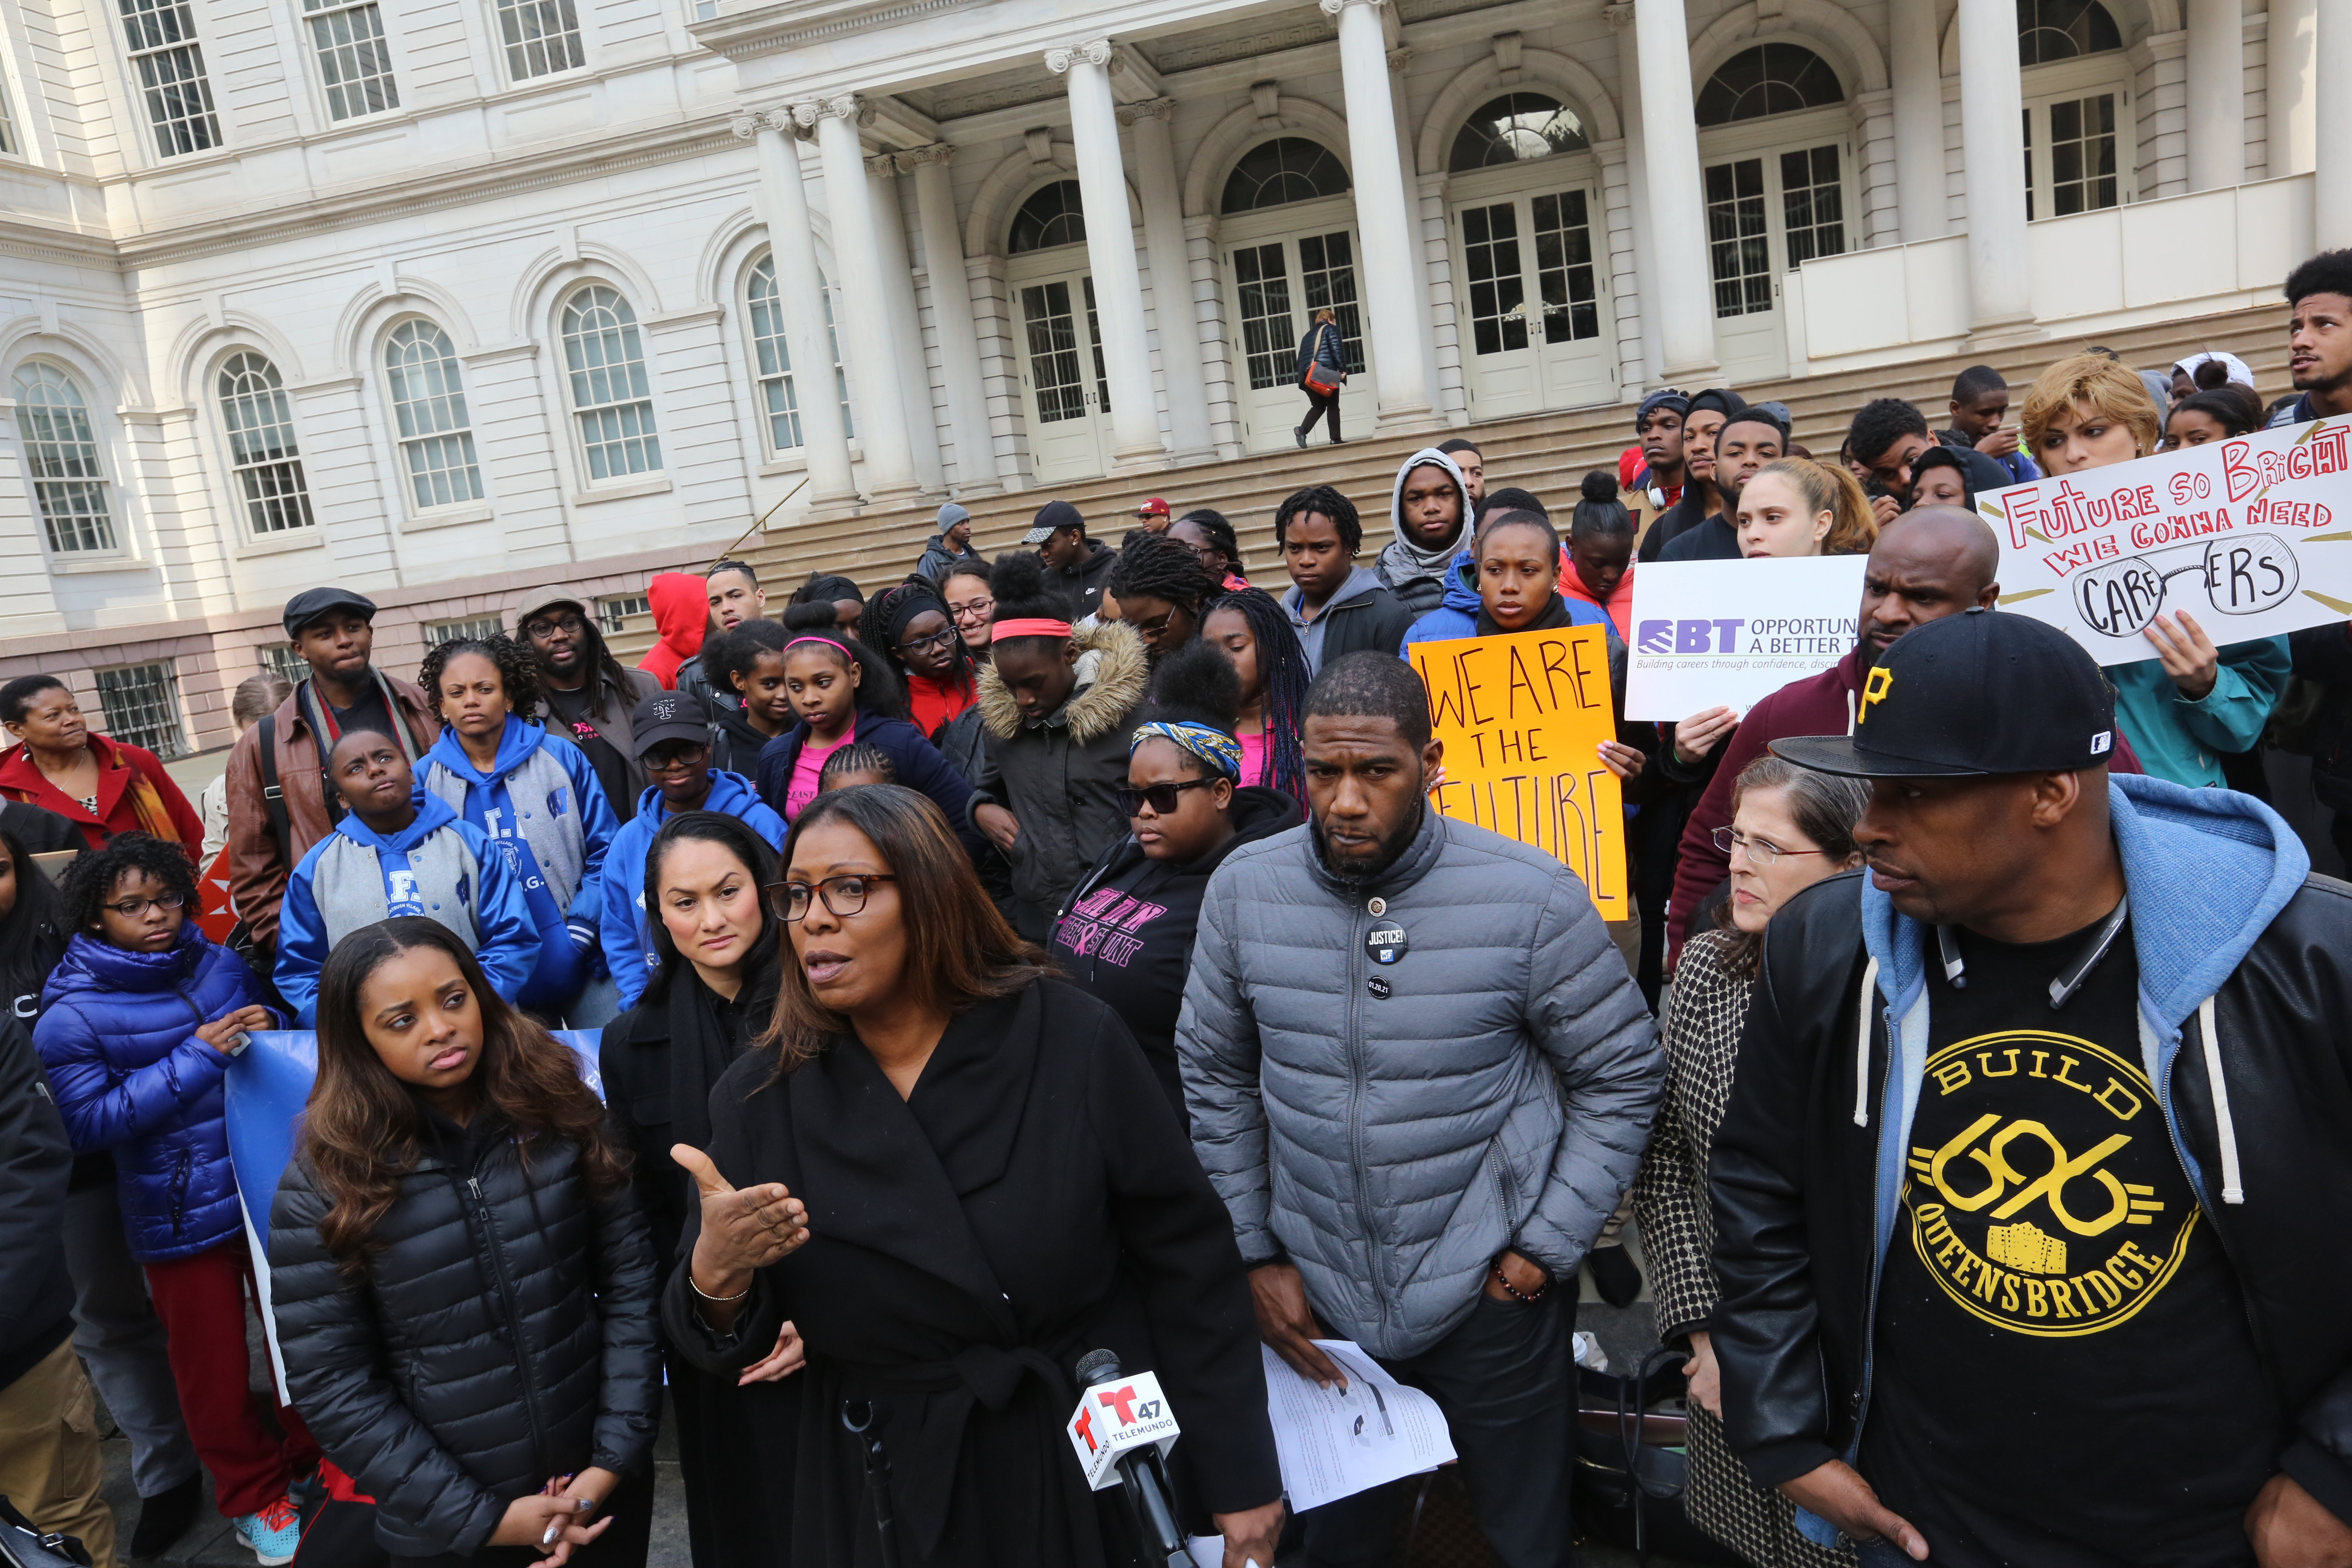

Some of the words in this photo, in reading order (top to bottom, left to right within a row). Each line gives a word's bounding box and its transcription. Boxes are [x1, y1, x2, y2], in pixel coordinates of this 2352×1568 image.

[2168, 472, 2211, 505] SO
[2043, 535, 2120, 577] WE
[2131, 508, 2233, 548] GONNA
[2247, 499, 2332, 527] NEED
[1749, 638, 1762, 653] A
[1771, 637, 1840, 653] BETTER
[1636, 659, 1673, 670] Building
[1677, 660, 1708, 669] careers
[1712, 659, 1749, 670] through
[1753, 658, 1806, 670] confidence,
[1421, 648, 1494, 728] WE
[1511, 639, 1601, 719] ARE
[1858, 666, 1893, 725] P
[1471, 728, 1548, 768] THE
[1369, 929, 1403, 945] JUSTICE!
[1368, 981, 1388, 993] 01.20.21
[1932, 1049, 2142, 1120] BUILD
[1915, 1203, 2164, 1318] QUEENSBRIDGE
[1138, 1399, 1160, 1419] 47
[1323, 1391, 1336, 1414] earnings
[1112, 1419, 1173, 1442] TELEMUNDO
[1087, 1440, 1109, 1481] TELEMUNDO
